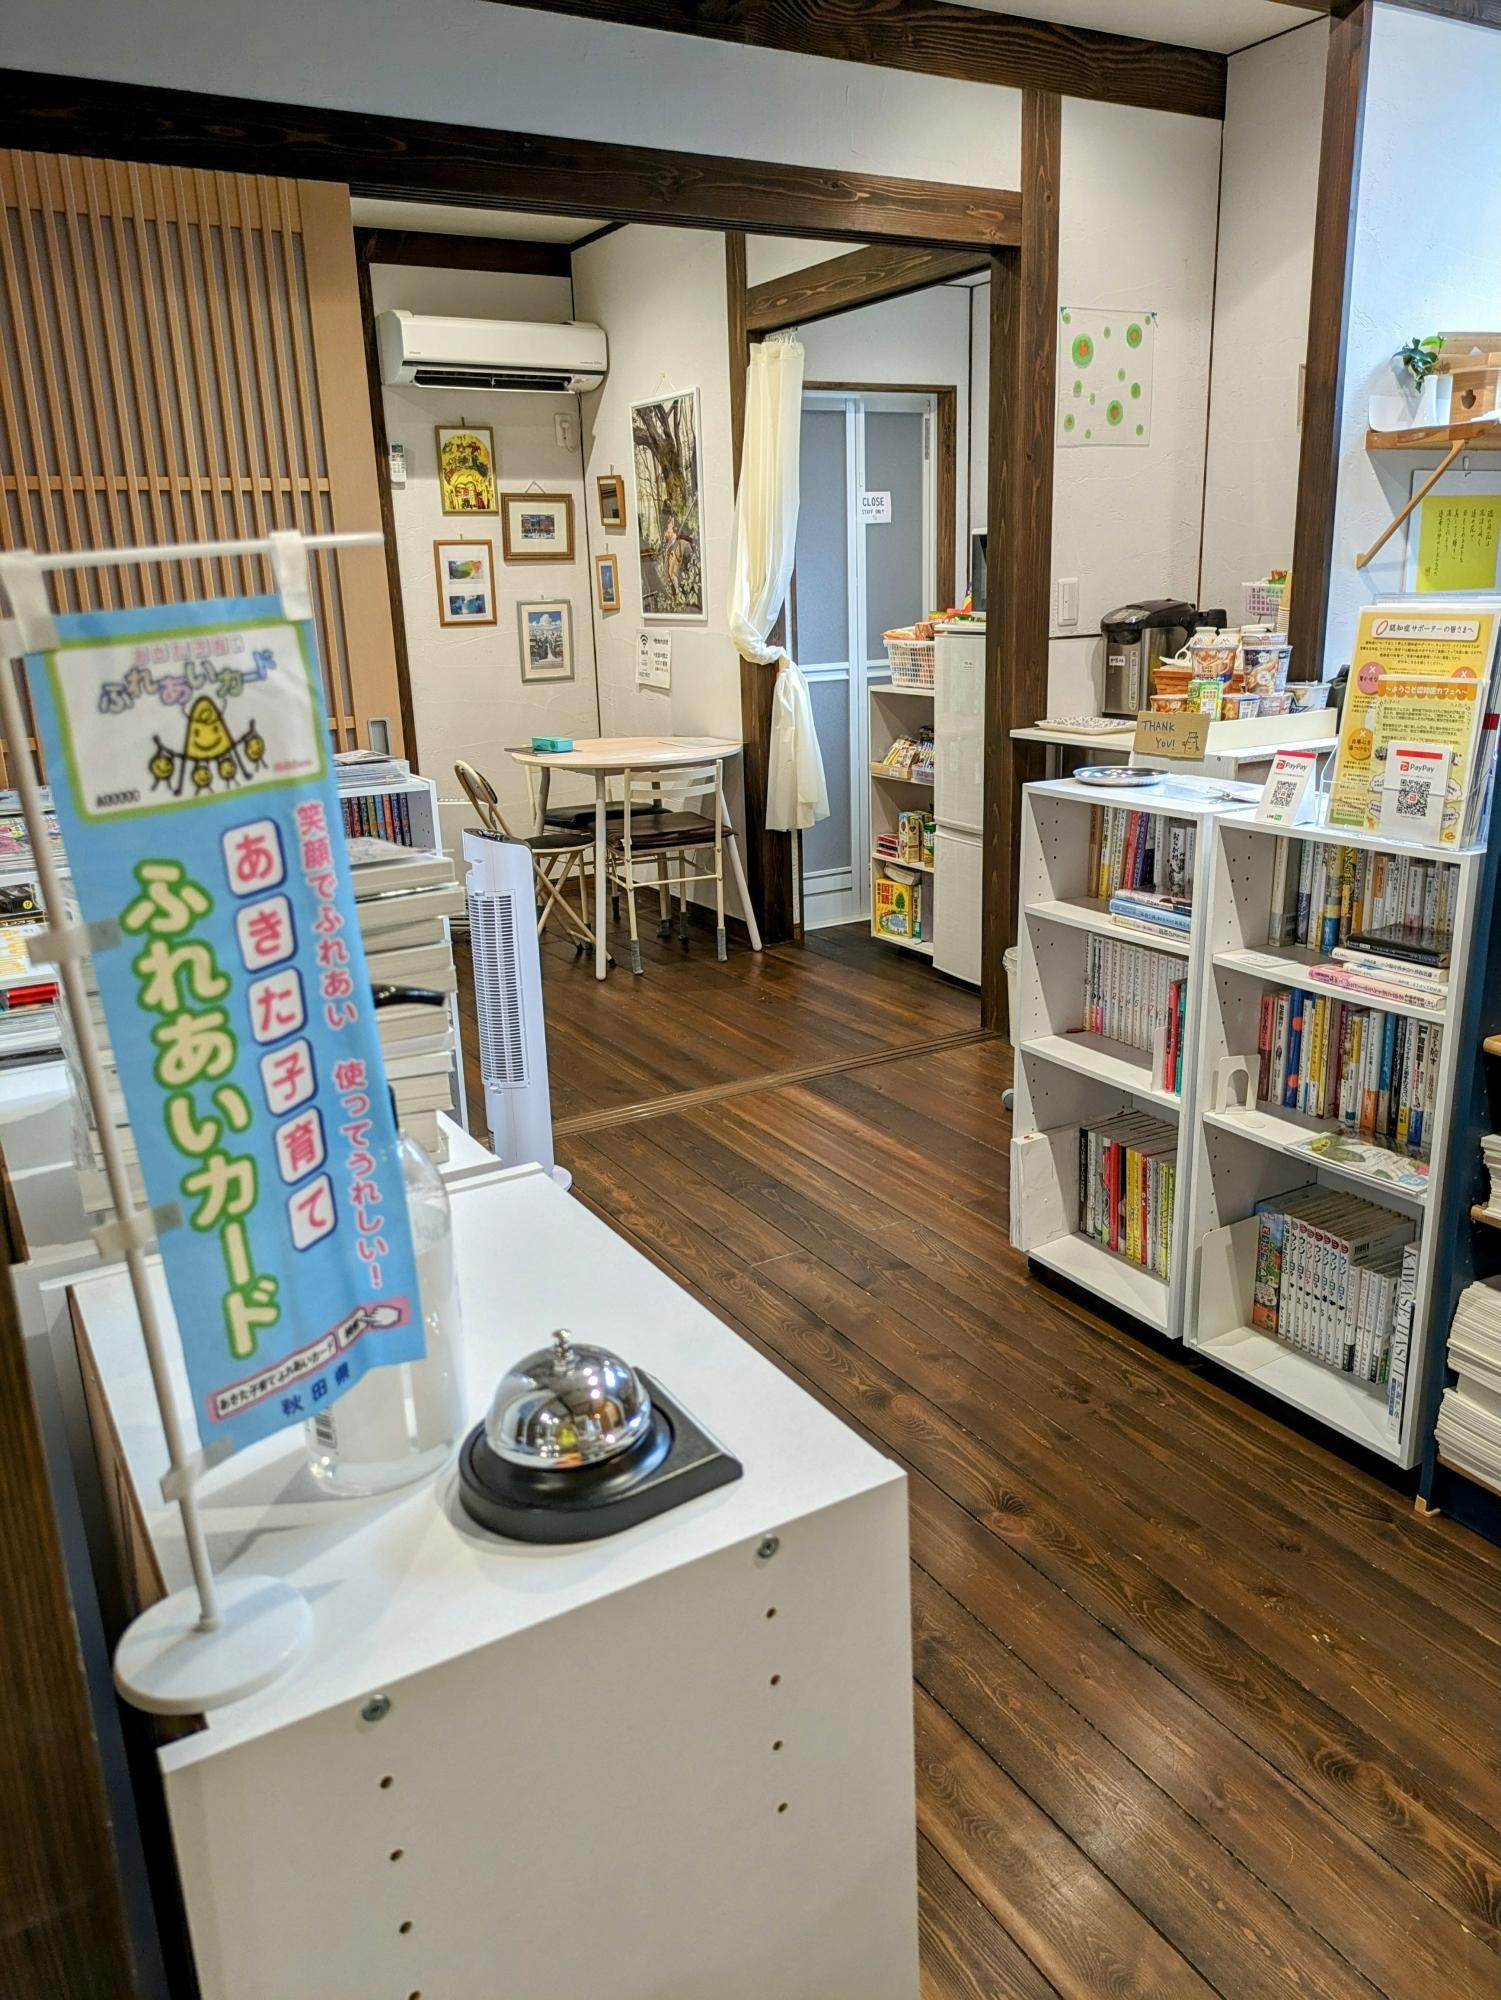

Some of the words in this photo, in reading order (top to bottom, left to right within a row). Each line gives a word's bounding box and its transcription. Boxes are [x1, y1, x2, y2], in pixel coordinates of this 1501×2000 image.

[862, 497, 885, 507] CLOSE
[98, 648, 277, 714] ふれあいカード
[1141, 720, 1176, 732] THANK
[1285, 761, 1308, 771] PayPay
[1410, 763, 1435, 773] PayPay
[295, 799, 358, 1030] 笑顔でふれあい
[233, 831, 331, 1233] あきた子育て
[120, 859, 280, 1359] ふれあいカード
[281, 1361, 350, 1416] 秋田県
